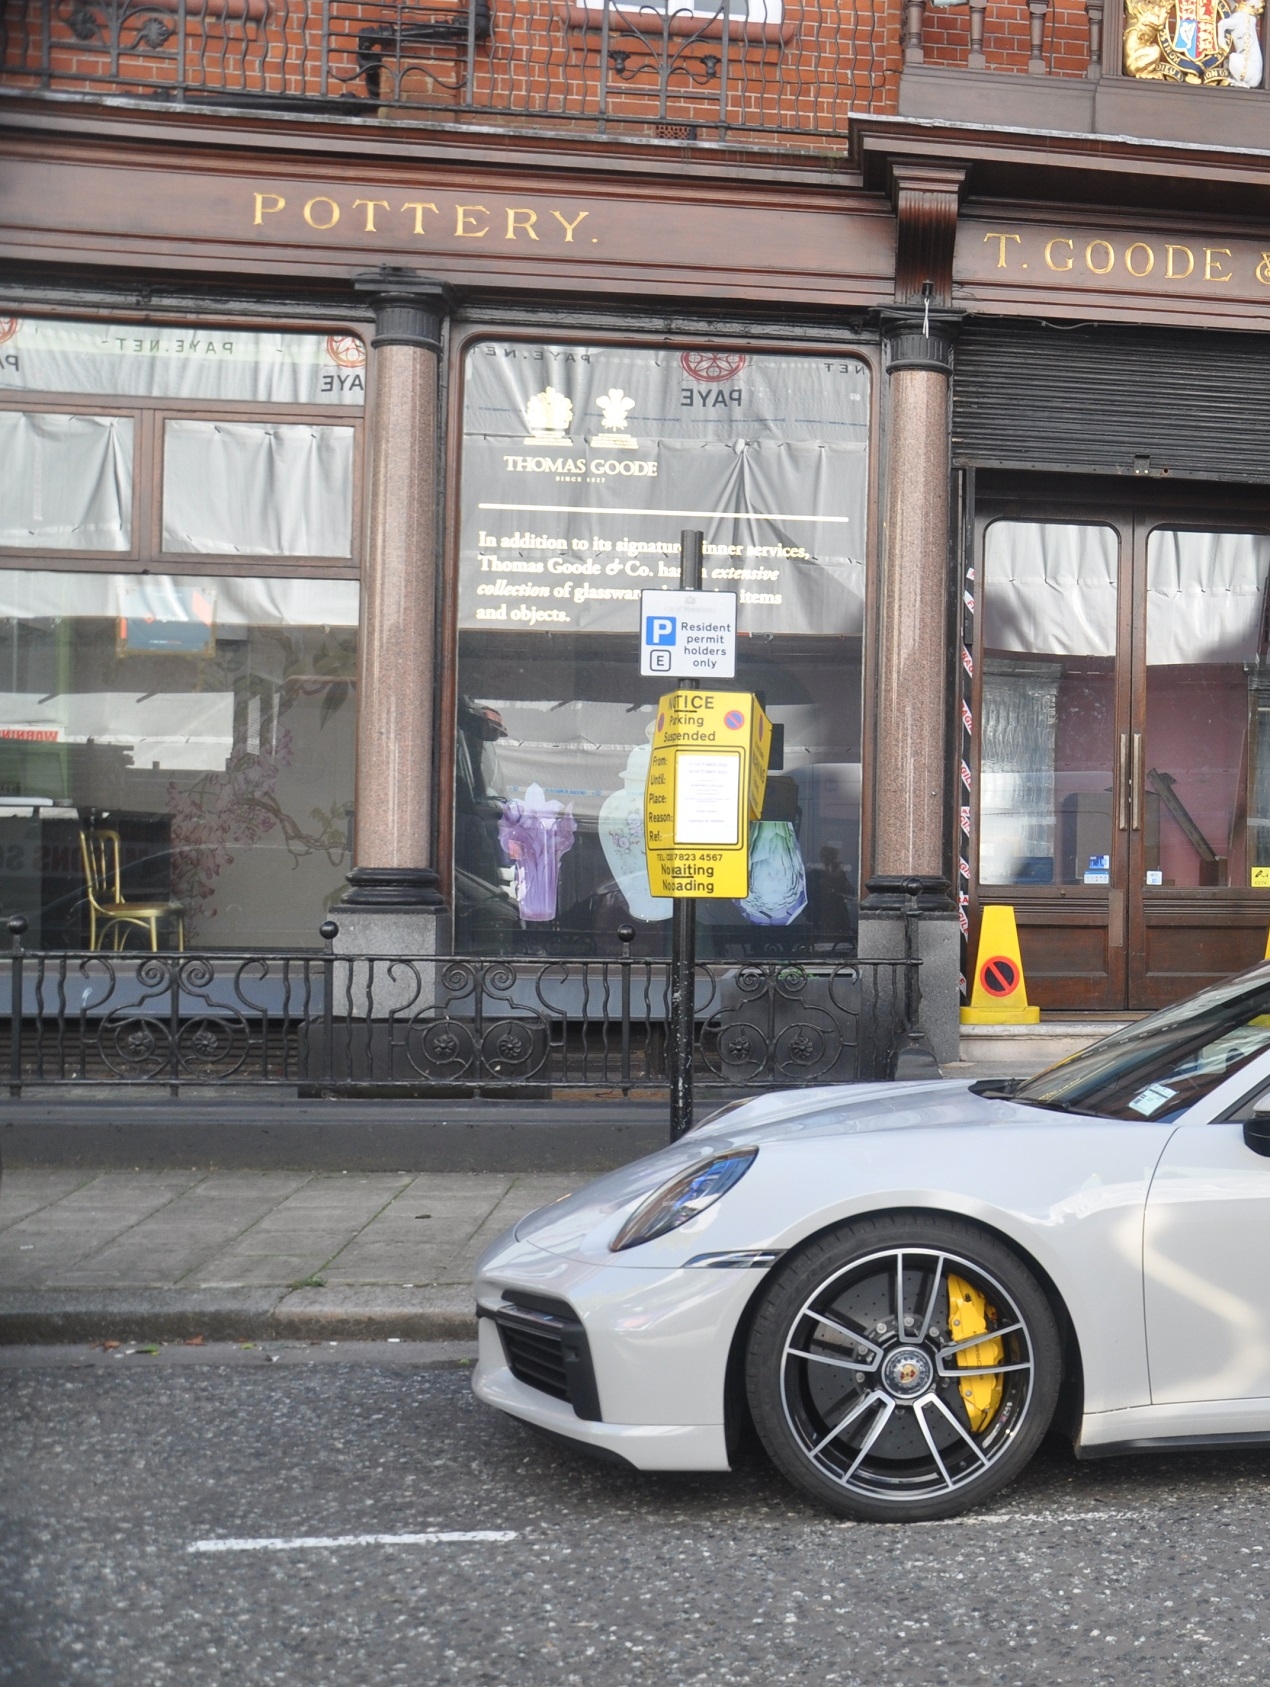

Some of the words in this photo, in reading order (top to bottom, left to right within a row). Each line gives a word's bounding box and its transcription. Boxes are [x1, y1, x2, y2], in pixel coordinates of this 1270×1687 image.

[252, 192, 599, 244] POTTERY.
[983, 232, 1028, 269] T.
[1044, 238, 1233, 283] GOODE
[503, 455, 586, 474] THOMAS
[589, 457, 658, 478] GOODE
[479, 531, 497, 547] In
[500, 532, 568, 550] addition
[572, 538, 589, 550] to
[592, 536, 612, 551] its
[615, 537, 682, 557] signatur
[702, 540, 744, 556] inner
[746, 543, 810, 560] services,
[477, 555, 544, 573] Thomas
[547, 557, 601, 575] Goode
[605, 558, 624, 576] &
[624, 560, 654, 576] Co.
[711, 566, 780, 581] extensive
[477, 579, 550, 597] collection
[553, 581, 573, 598] of
[573, 582, 641, 603] glasswar
[739, 589, 782, 604] items
[476, 603, 507, 620] and
[510, 604, 571, 626] objects.
[652, 619, 673, 643] P
[681, 622, 731, 632] Resident
[686, 635, 724, 644] permit
[656, 655, 664, 666] E
[684, 646, 727, 656] holders
[692, 658, 717, 669] only
[668, 695, 714, 710] NOTICE
[669, 714, 704, 727] Parking
[664, 731, 716, 743] Suspended
